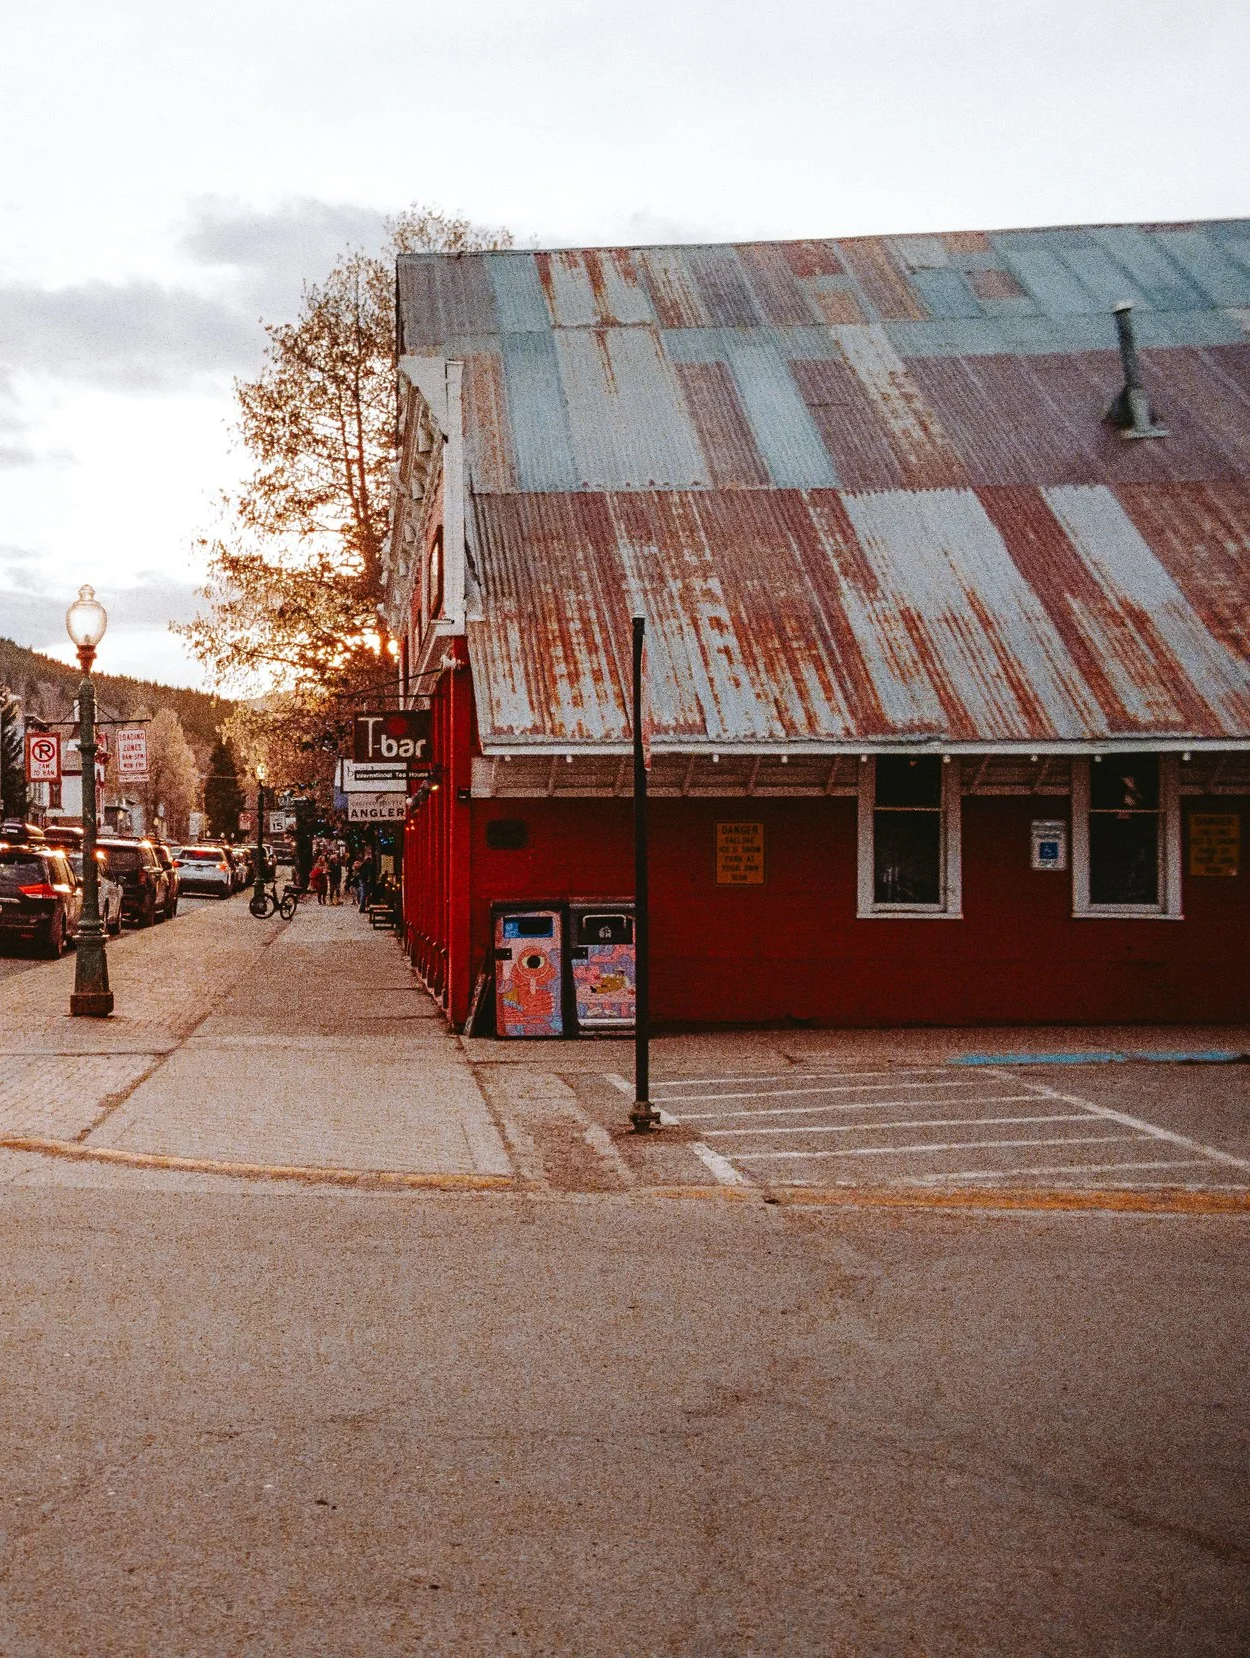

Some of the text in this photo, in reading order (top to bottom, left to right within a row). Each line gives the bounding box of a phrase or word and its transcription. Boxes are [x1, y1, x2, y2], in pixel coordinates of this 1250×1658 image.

[119, 733, 145, 741] LOADING
[357, 717, 427, 758] T-bar
[350, 808, 405, 818] ANGLER
[272, 822, 283, 831] 15
[721, 825, 759, 835] DANGER
